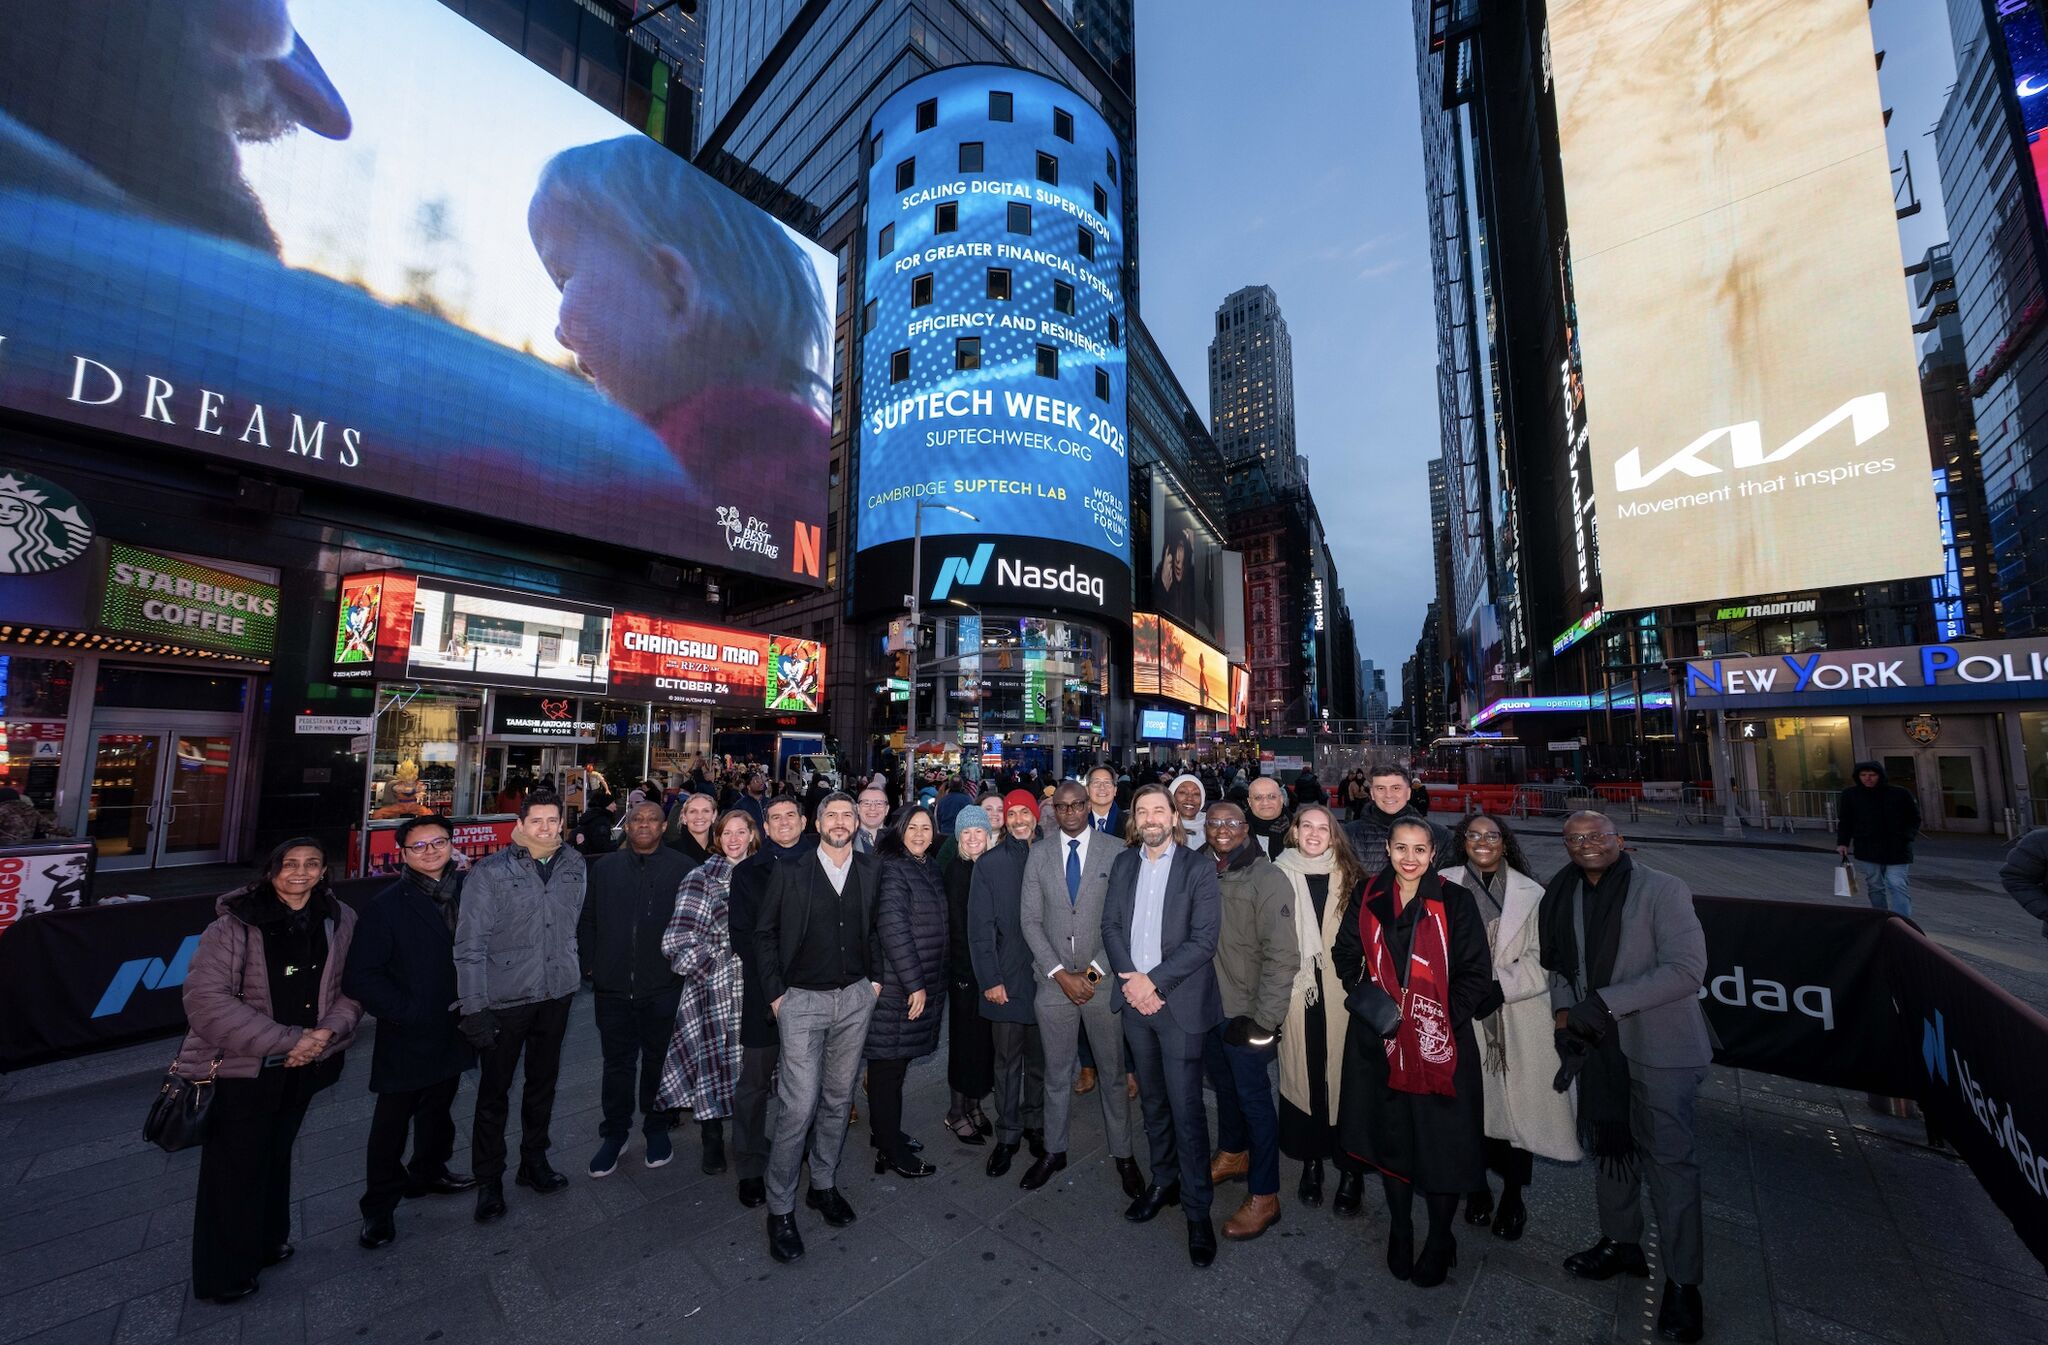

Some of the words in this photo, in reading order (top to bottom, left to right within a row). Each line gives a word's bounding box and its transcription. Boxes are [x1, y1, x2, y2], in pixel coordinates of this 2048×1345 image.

[902, 181, 967, 210] SCALING
[971, 180, 1032, 200] DIGITAL
[1036, 189, 1110, 243] SUPERVISION
[895, 253, 921, 274] FOR
[924, 243, 992, 263] GREATER
[997, 244, 1077, 277] FINANCIAL
[1080, 268, 1114, 304] SYSTEM
[908, 313, 995, 336] EFFICIENCY
[1000, 314, 1036, 331] AND
[1041, 320, 1106, 360] RESILIENCE
[67, 355, 361, 467] DREAMS
[1561, 359, 1576, 447] NOW
[873, 389, 992, 435] SUPTECH
[1004, 391, 1082, 432] WEEK
[1088, 413, 1125, 458] 2025
[926, 428, 1092, 461] SUPTECHWEEK.ORG
[868, 481, 947, 509] CAMBRIDGE
[954, 479, 1032, 495] SUPTECH
[1038, 484, 1067, 501] LAB
[1093, 487, 1123, 512] WORLD
[1618, 485, 1731, 519] Movement
[1737, 476, 1785, 497] that
[1795, 456, 1895, 488] inspires
[747, 516, 768, 533] FYC
[1084, 496, 1127, 529] ECONOMIC
[1094, 513, 1123, 537] FORUM
[1570, 444, 1588, 593] RESERVE
[733, 536, 778, 559] PICTURE
[743, 528, 771, 543] BEST
[113, 562, 276, 616] STARBUCKS
[997, 558, 1104, 606] Nasdaq
[1314, 579, 1324, 611] Locker
[143, 600, 246, 636] COFFEE
[1314, 612, 1324, 631] Foot
[1716, 600, 1816, 621] NEWTRADITION
[623, 631, 718, 661] CHAINSAW
[722, 645, 759, 666] MAN
[680, 661, 710, 673] REZE
[1686, 660, 1777, 697] NEW
[1782, 653, 1906, 692] YORK
[1920, 645, 2048, 686] POLI
[655, 678, 712, 692] OCTOBER
[714, 683, 728, 694] 24
[1547, 698, 1582, 707] opening
[573, 721, 595, 730] STORE
[462, 826, 492, 835] YOUR
[473, 834, 498, 842] LIST.
